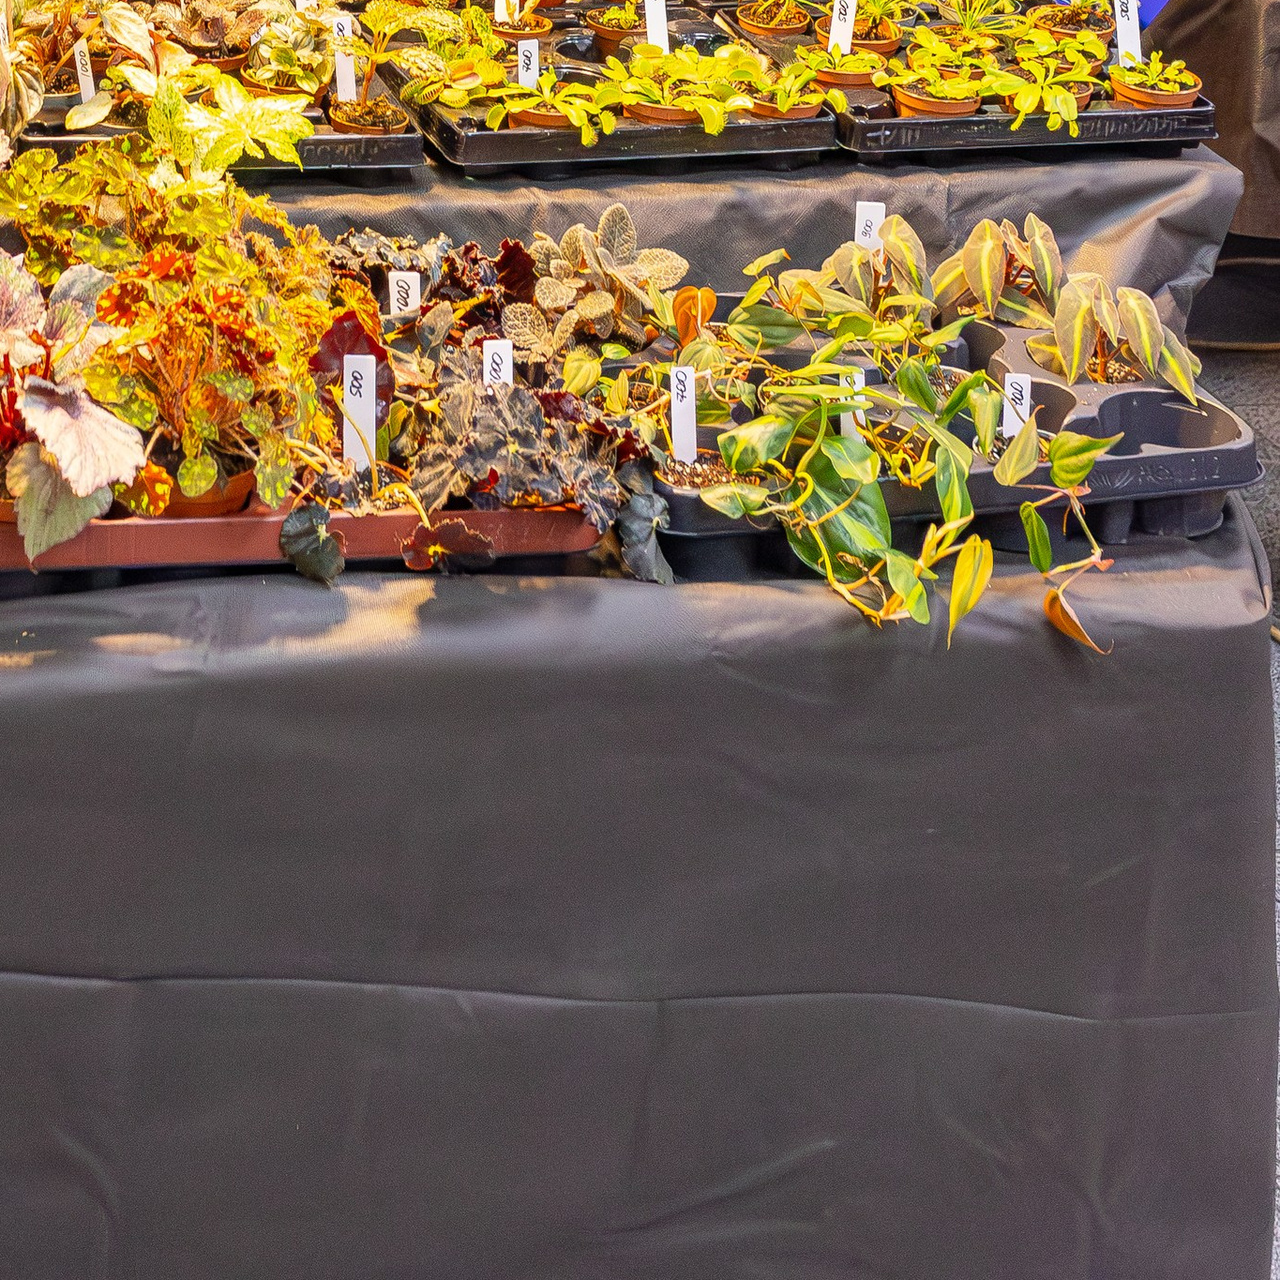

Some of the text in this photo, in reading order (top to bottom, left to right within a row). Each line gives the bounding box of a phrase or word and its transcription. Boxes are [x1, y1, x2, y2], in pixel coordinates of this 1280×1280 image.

[838, 0, 849, 23] 500
[78, 50, 90, 78] 1000
[861, 219, 873, 239] 900
[349, 370, 363, 398] 500
